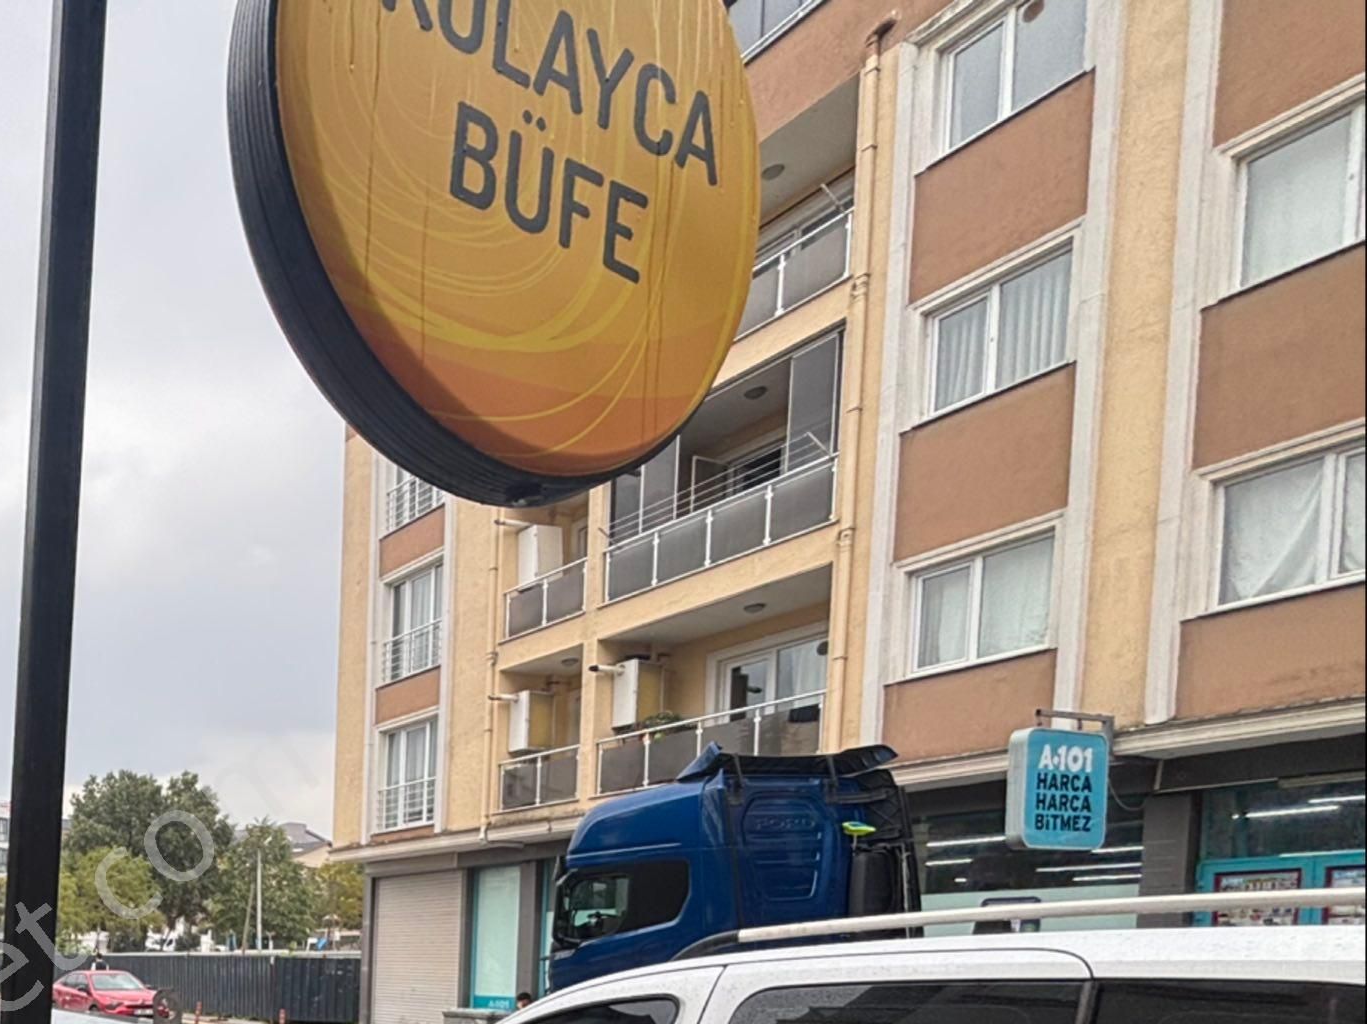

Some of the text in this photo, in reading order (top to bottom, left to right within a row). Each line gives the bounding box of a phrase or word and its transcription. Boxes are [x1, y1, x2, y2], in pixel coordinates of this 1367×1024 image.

[380, 0, 719, 187] OLAYCA
[448, 100, 649, 285] BÜFE
[1035, 793, 1092, 813] HARCA
[1036, 772, 1092, 793] HARCA
